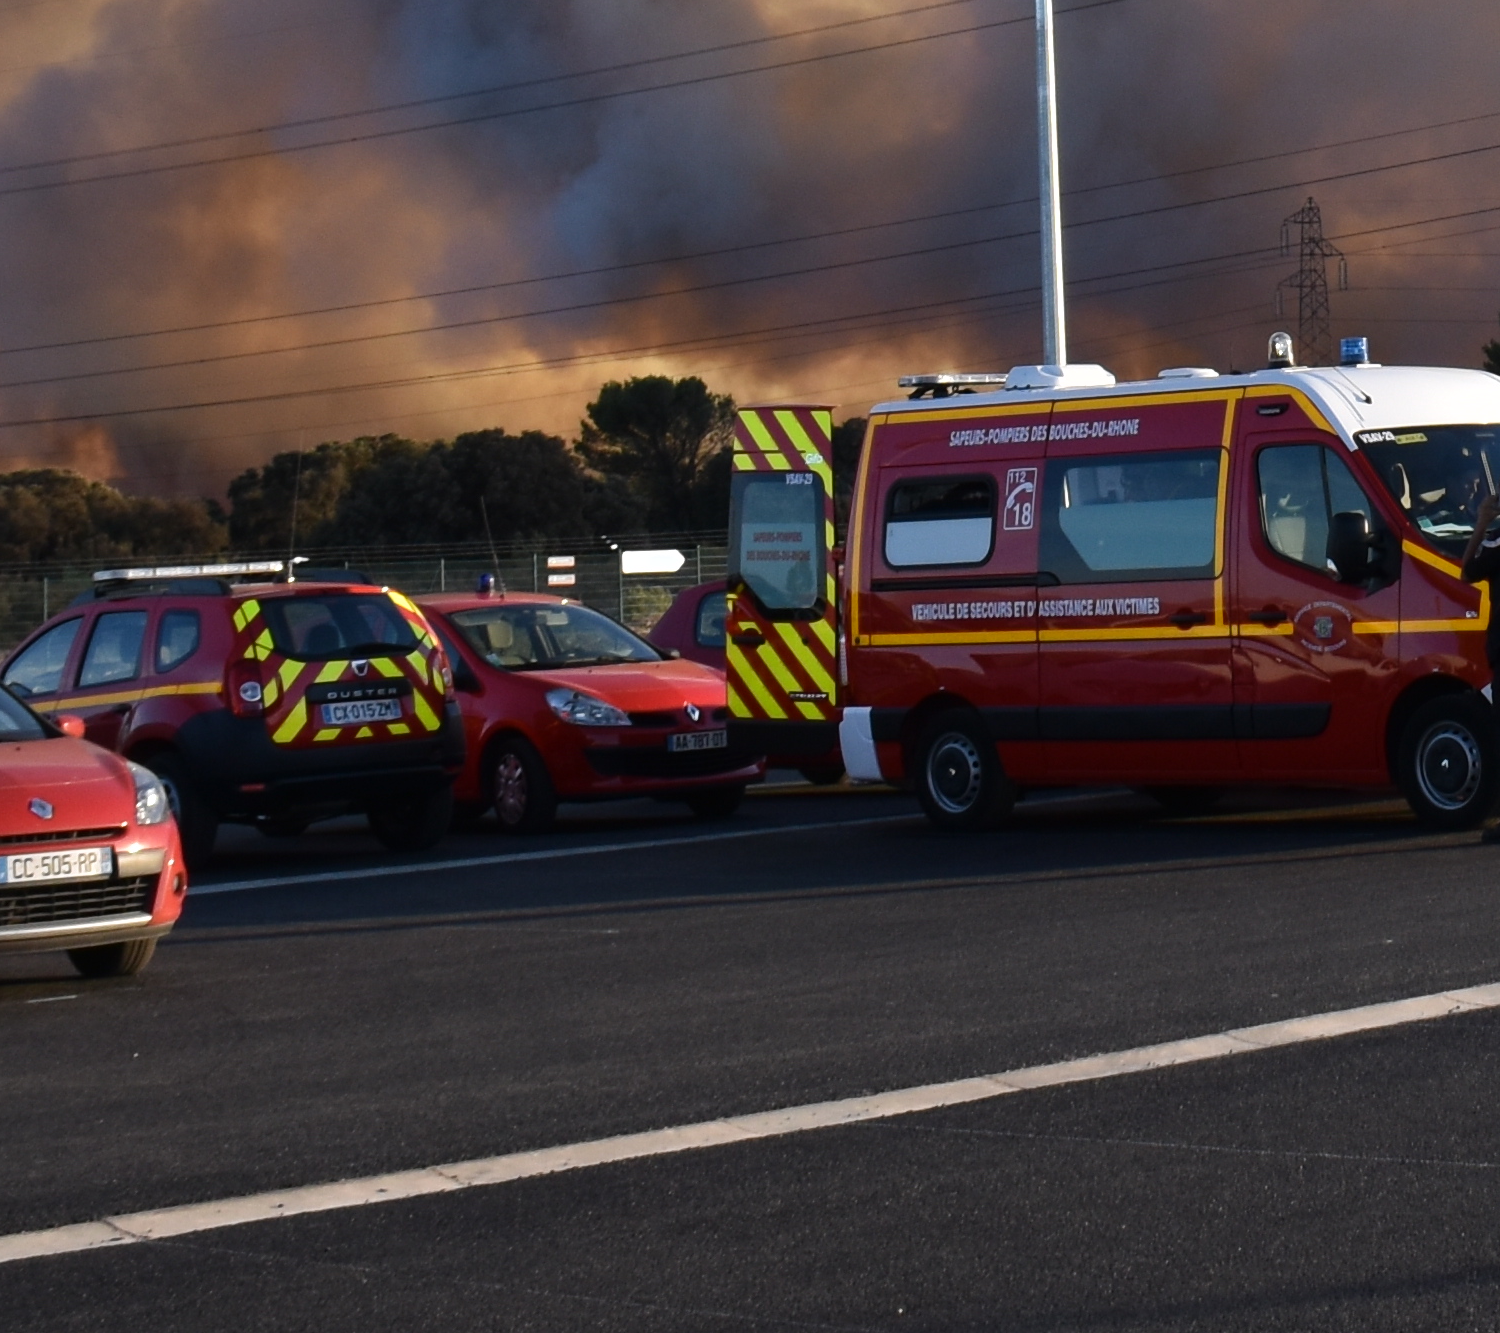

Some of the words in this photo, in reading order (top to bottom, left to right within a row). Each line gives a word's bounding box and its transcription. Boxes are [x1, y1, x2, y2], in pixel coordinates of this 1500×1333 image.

[949, 426, 1030, 447] SAPEURS-POMPIERS
[1031, 424, 1048, 441] DES
[1009, 471, 1027, 483] 112
[1012, 502, 1032, 526] 18
[911, 603, 955, 620] VEHICULE
[956, 602, 969, 619] DE
[970, 601, 1013, 619] SECOURS
[1014, 600, 1026, 617] ET
[1094, 598, 1114, 616] AUX
[1115, 597, 1160, 615] VICTIMES
[327, 687, 397, 700] DUSTER
[13, 852, 98, 879] CC-505-RP
